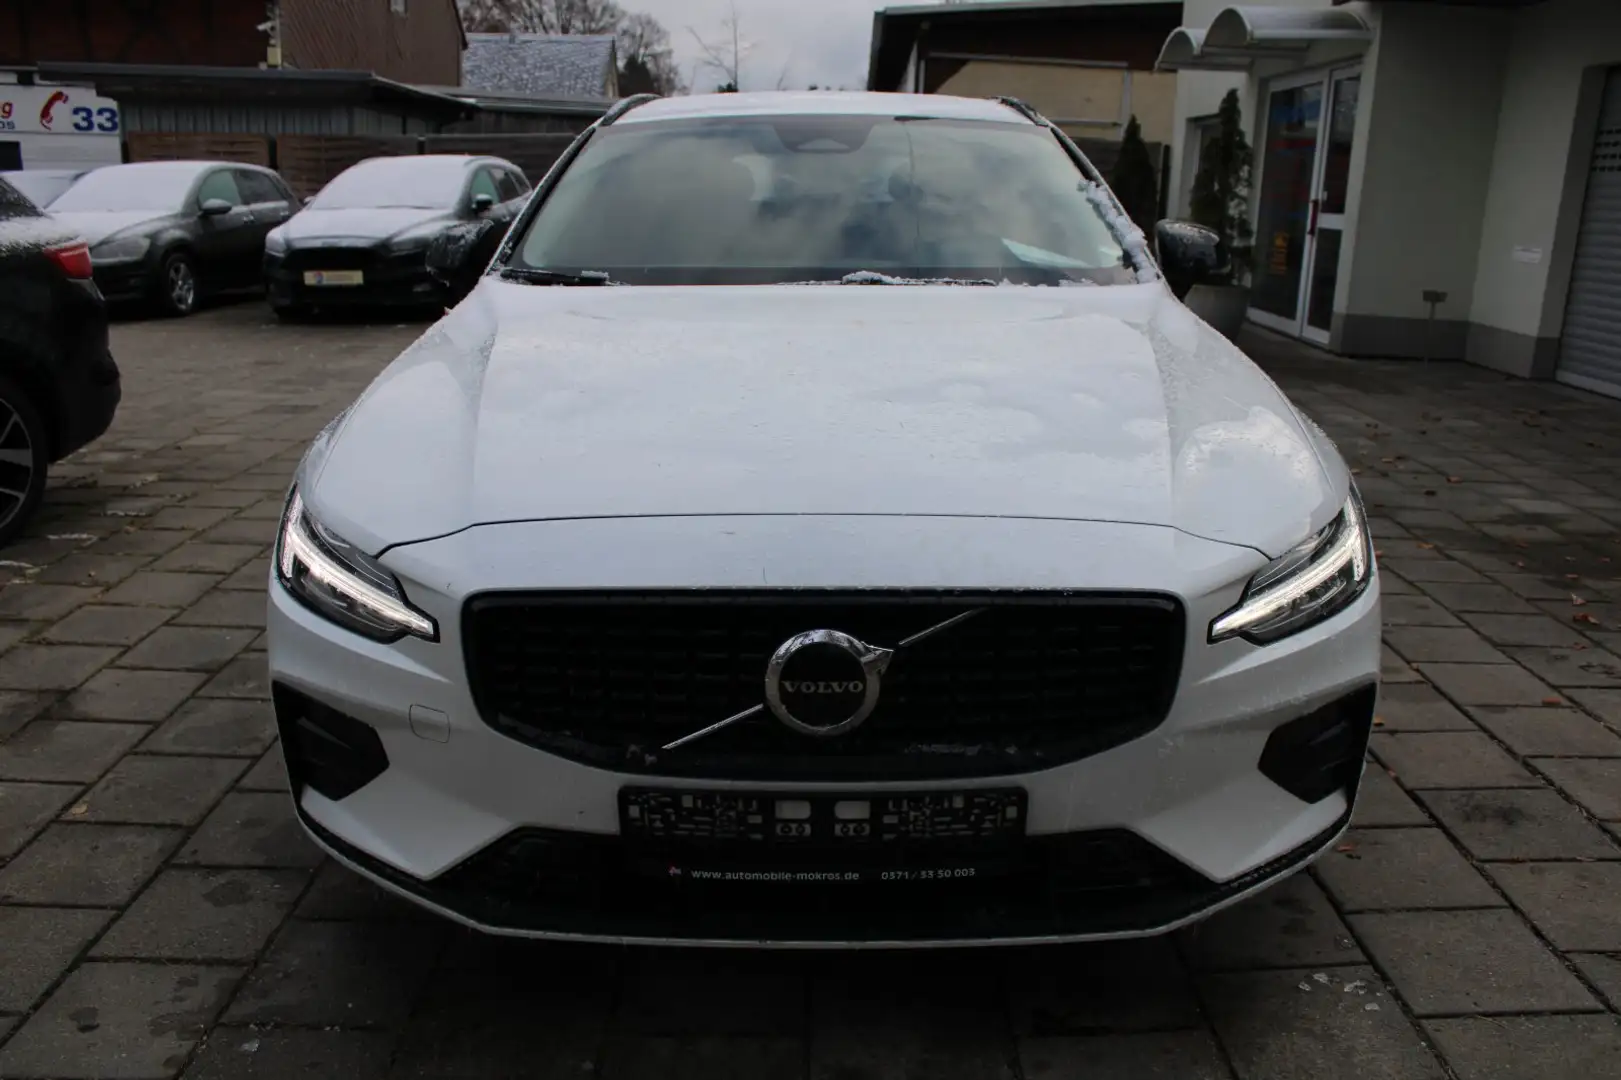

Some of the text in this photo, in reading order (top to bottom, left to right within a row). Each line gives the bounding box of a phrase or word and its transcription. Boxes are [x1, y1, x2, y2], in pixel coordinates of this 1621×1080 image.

[72, 106, 119, 132] 33
[781, 680, 864, 693] VOLVO
[690, 869, 860, 881] www.automobile-mokros.de
